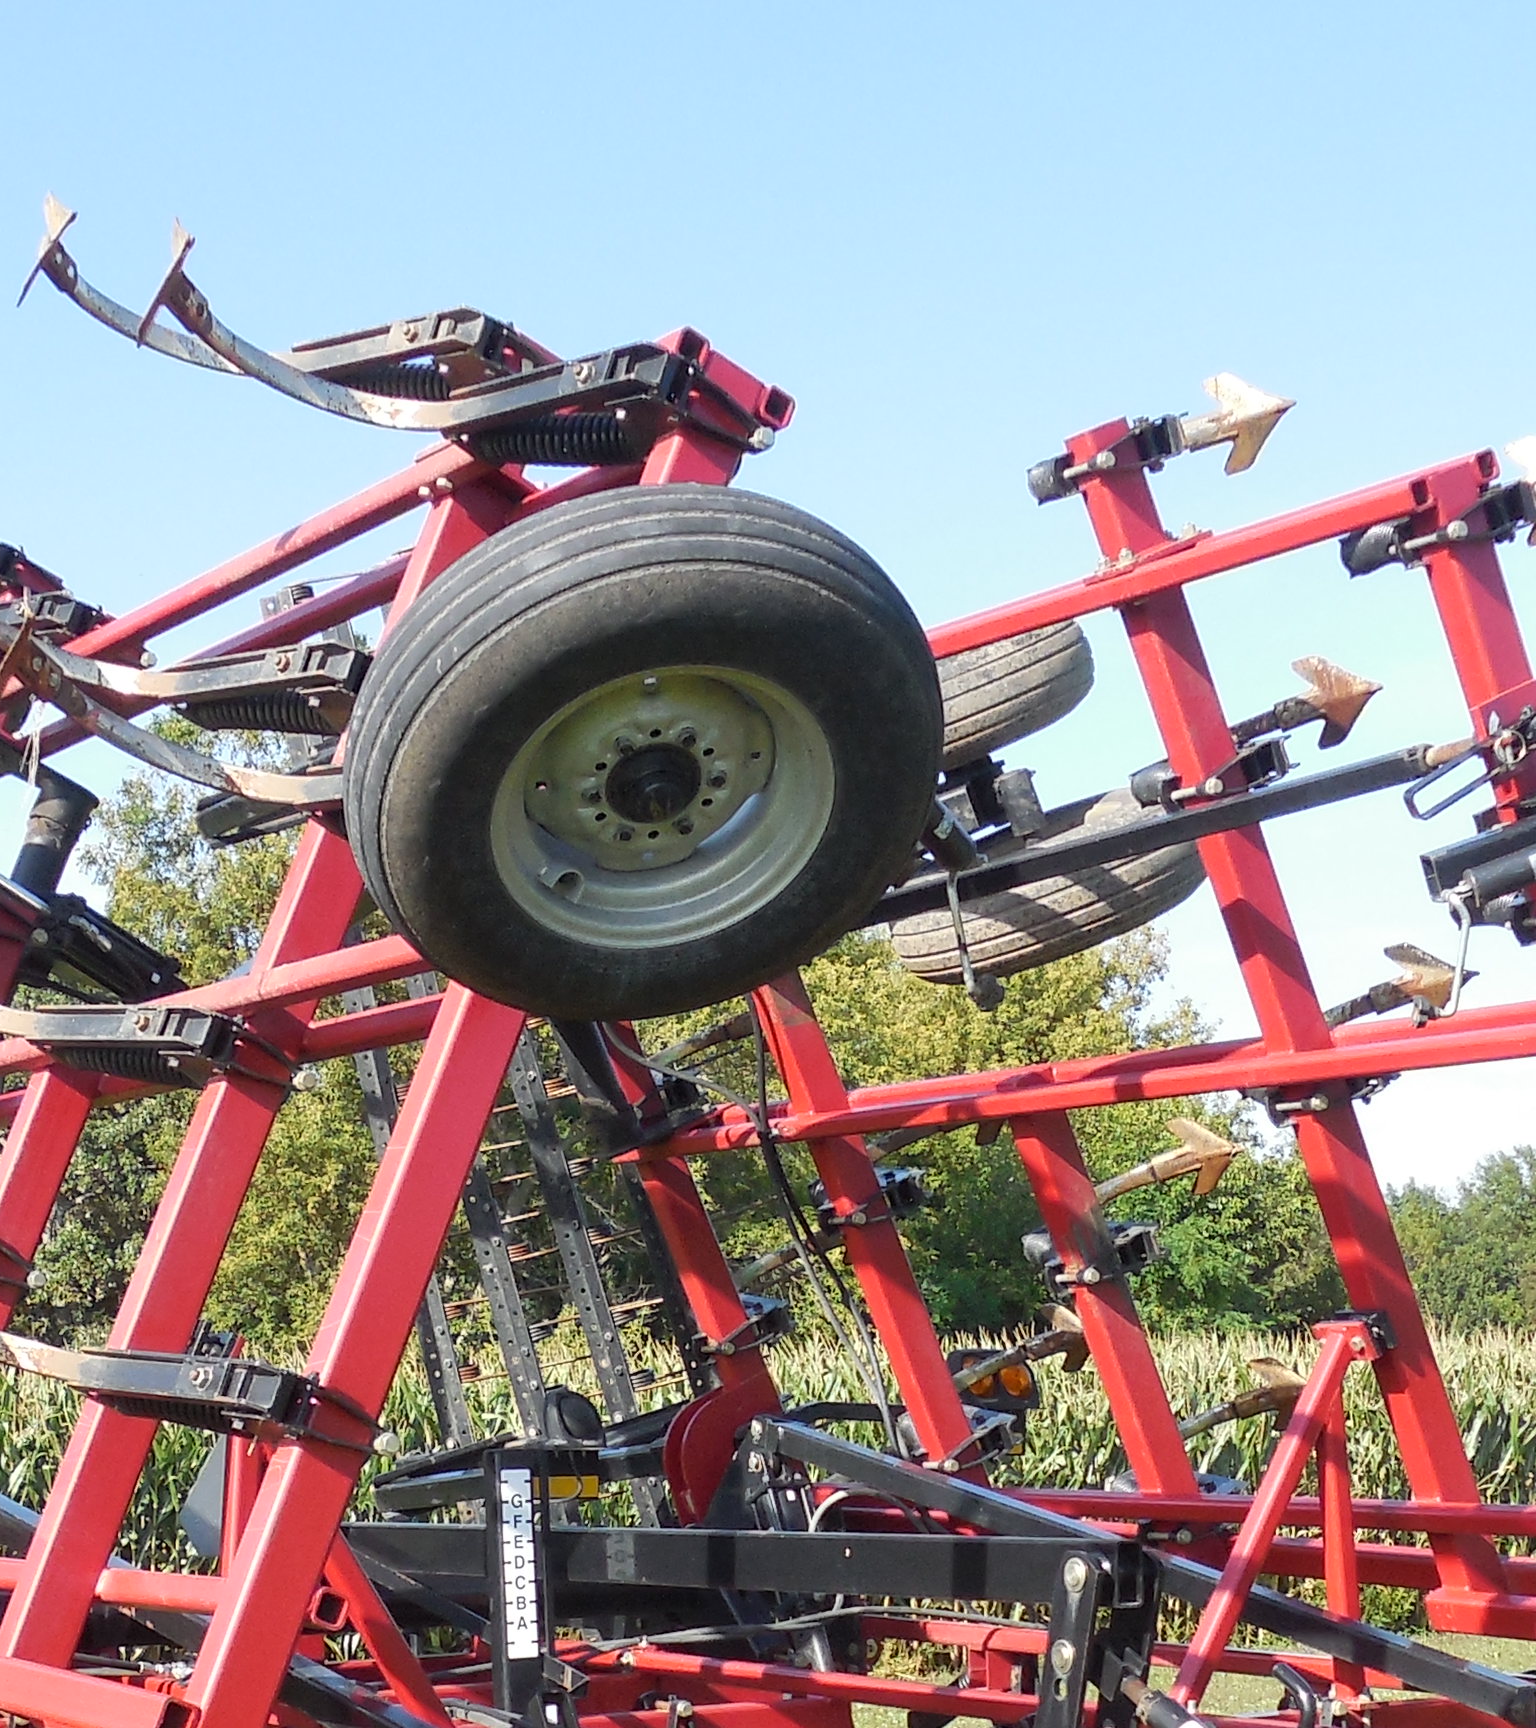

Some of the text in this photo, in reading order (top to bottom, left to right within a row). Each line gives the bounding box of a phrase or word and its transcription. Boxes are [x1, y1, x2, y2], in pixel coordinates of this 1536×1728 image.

[510, 1493, 523, 1509] G
[513, 1514, 523, 1529] F
[514, 1534, 524, 1549] E
[514, 1555, 525, 1569] D
[514, 1575, 526, 1590] C
[516, 1595, 527, 1610] B
[516, 1616, 528, 1631] A
